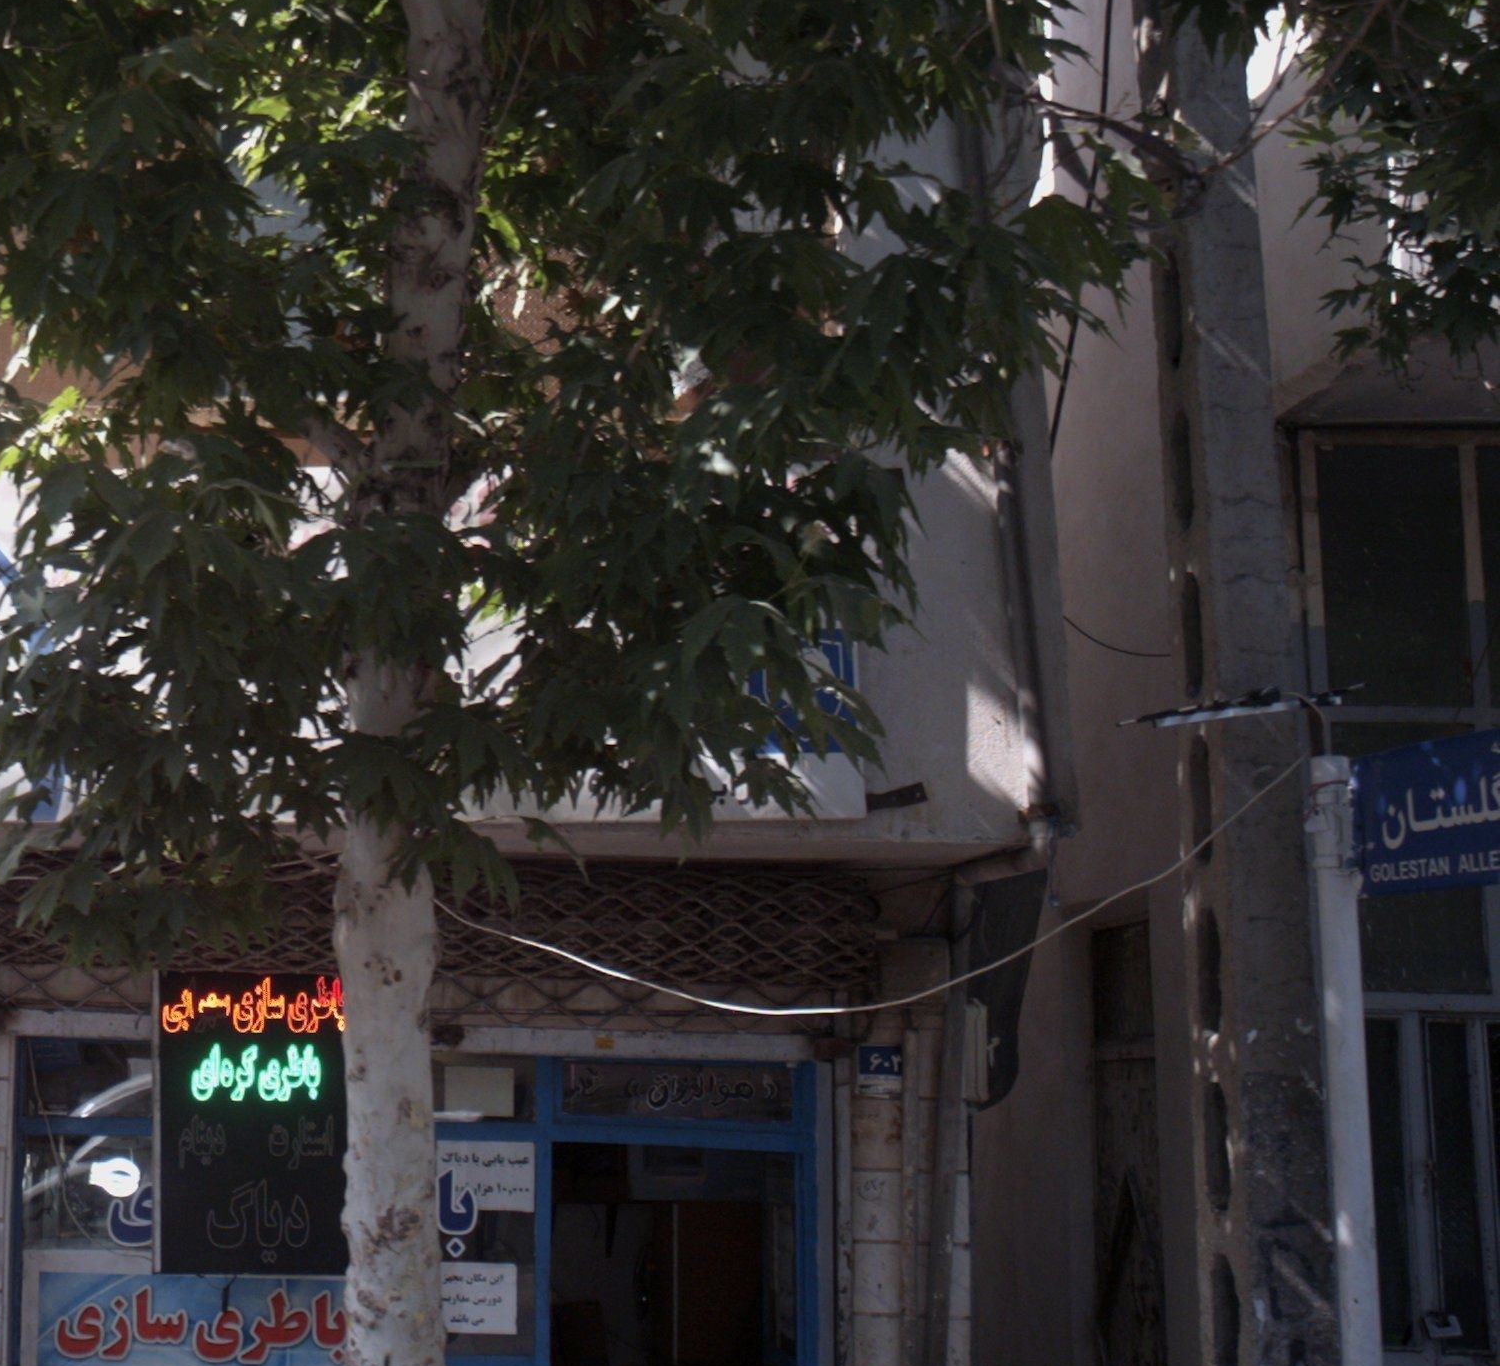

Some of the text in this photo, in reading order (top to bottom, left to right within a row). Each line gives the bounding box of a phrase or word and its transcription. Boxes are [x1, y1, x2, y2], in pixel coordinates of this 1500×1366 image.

[1369, 855, 1451, 884] GOLESTAN
[233, 976, 285, 1033] سازی
[259, 1043, 321, 1102] باطری
[55, 1284, 347, 1365] باطری سازی
